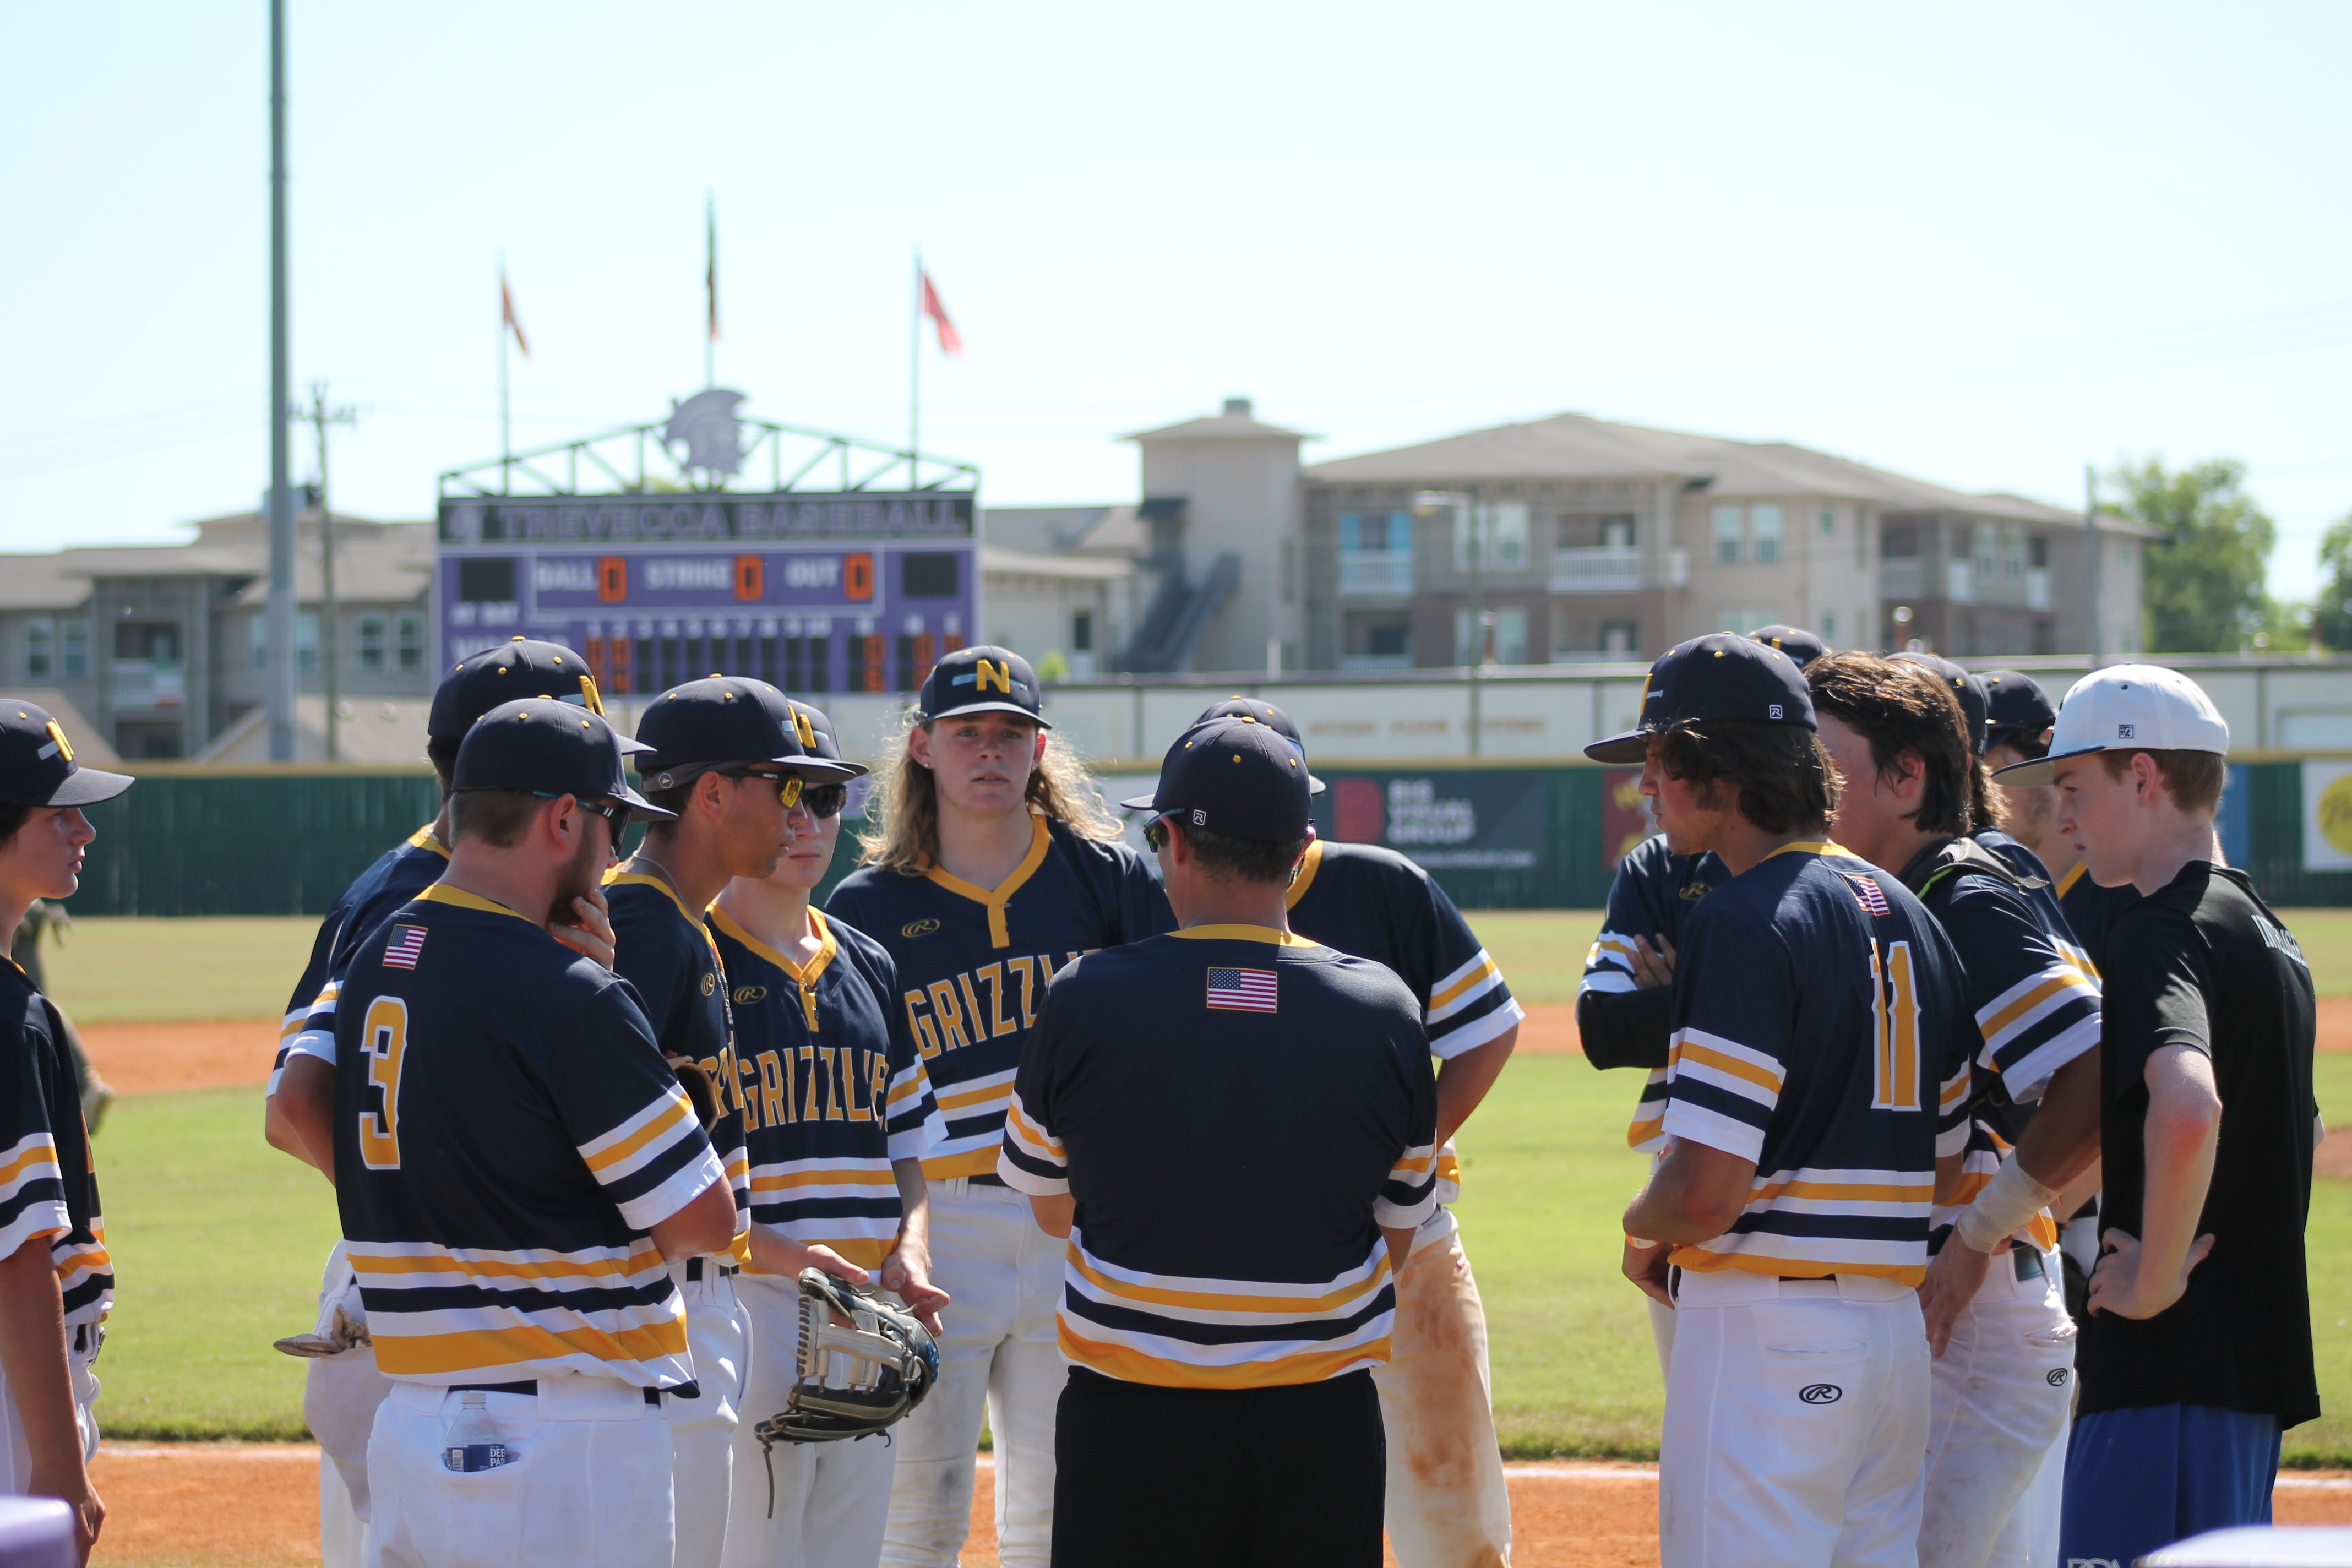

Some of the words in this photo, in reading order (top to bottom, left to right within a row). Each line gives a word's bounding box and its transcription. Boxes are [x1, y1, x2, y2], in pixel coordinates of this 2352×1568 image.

[500, 503, 730, 538] TREVECCA
[739, 500, 967, 535] BASEBALL
[538, 560, 597, 591] BALL
[645, 558, 731, 590] STRIKE
[786, 557, 839, 589] OUT
[977, 659, 1010, 694] N
[1870, 937, 1921, 1111] 11
